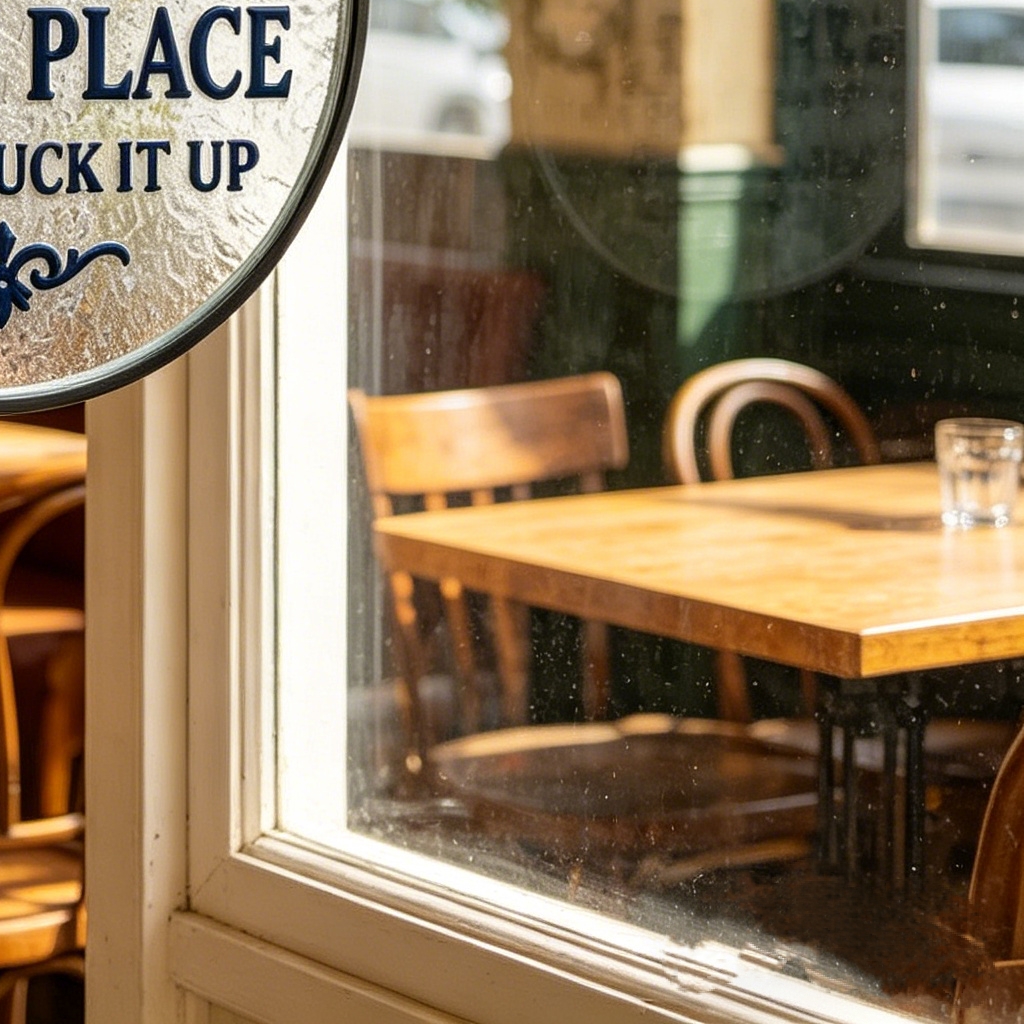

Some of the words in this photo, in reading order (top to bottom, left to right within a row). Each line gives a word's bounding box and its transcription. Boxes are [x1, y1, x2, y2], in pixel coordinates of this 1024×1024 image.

[27, 5, 293, 100] PLACE
[117, 140, 171, 193] IT
[188, 139, 260, 192] UP
